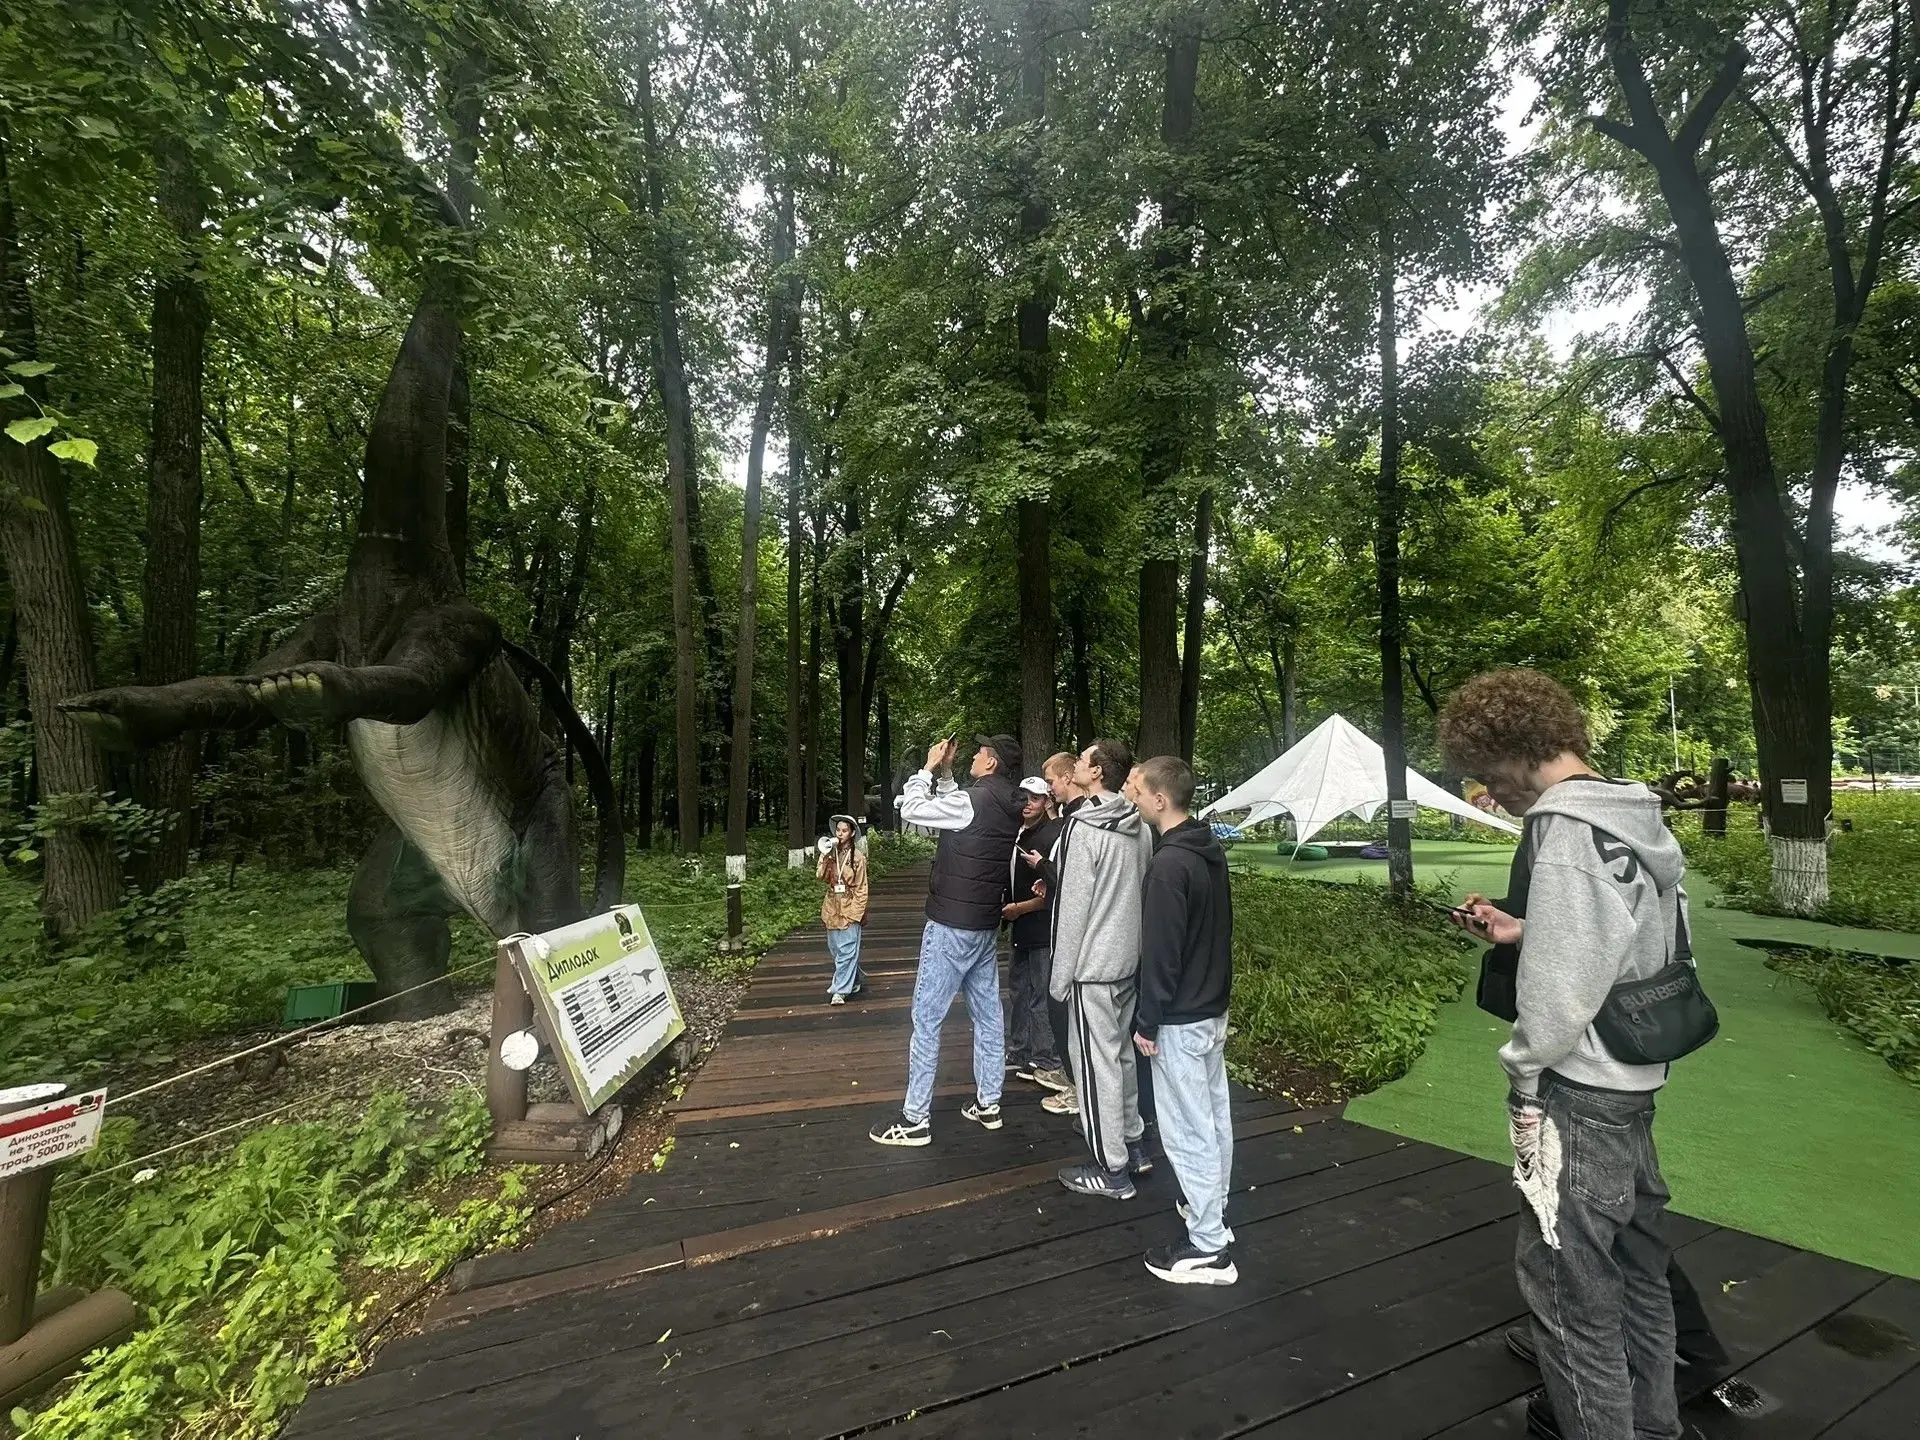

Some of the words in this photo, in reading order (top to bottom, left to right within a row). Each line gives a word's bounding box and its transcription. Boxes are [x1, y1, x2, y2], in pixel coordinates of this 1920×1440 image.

[8, 1121, 77, 1148] Динозавров
[0, 1154, 33, 1170] траф
[37, 1142, 65, 1158] 5000
[66, 1135, 88, 1150] руб
[9, 1147, 24, 1156] не
